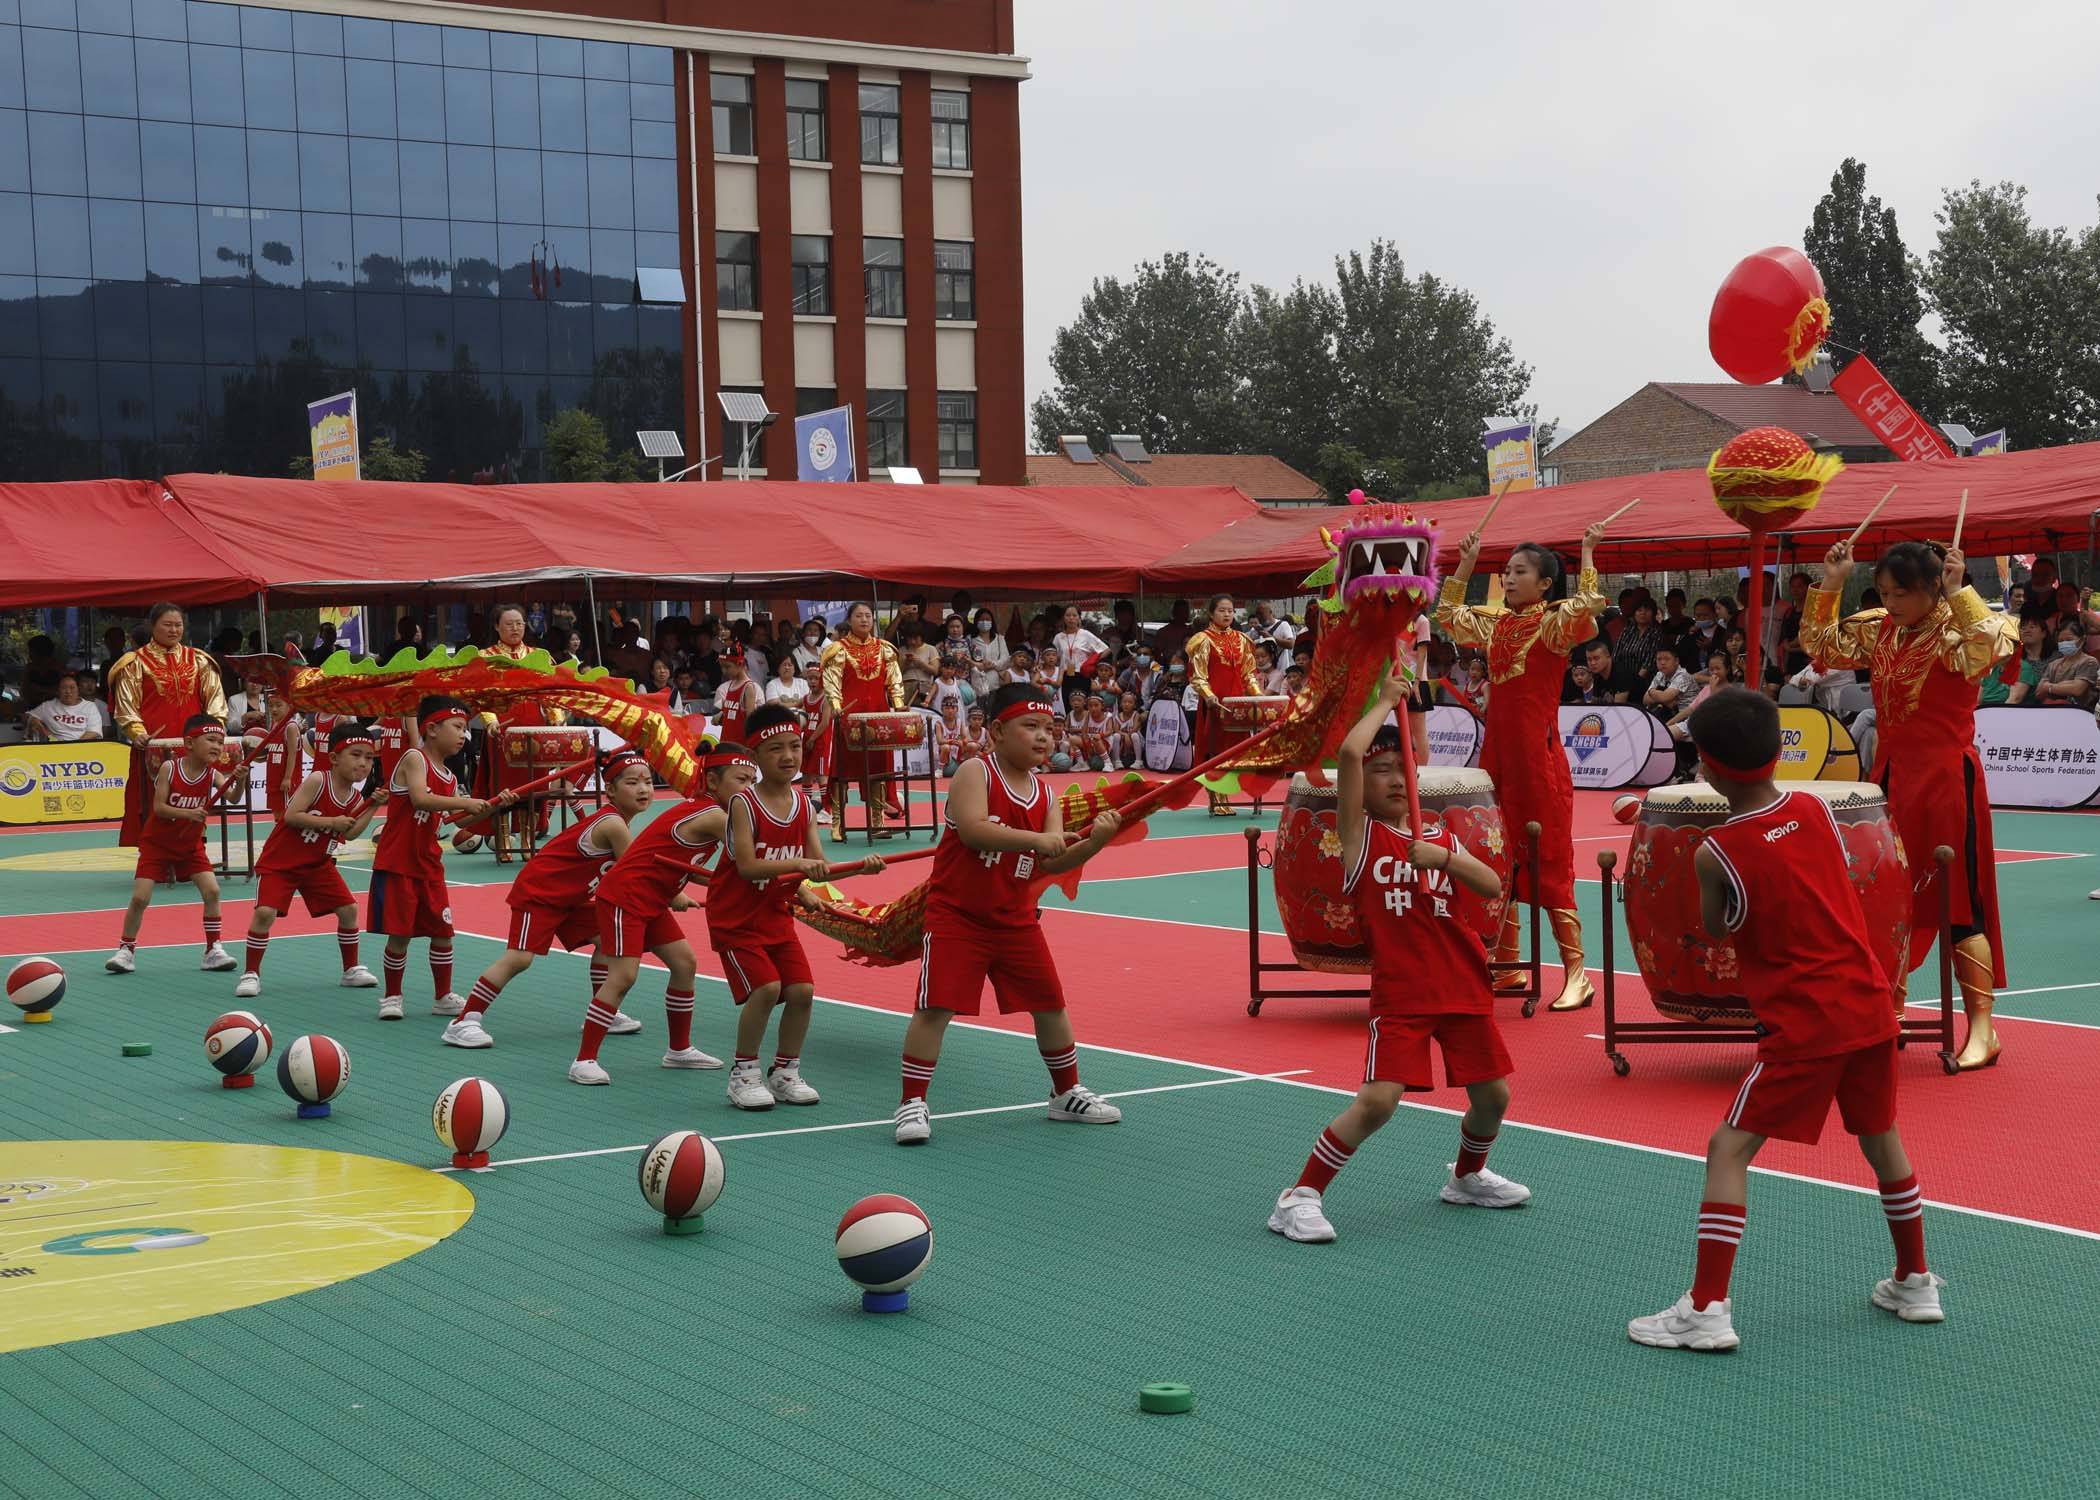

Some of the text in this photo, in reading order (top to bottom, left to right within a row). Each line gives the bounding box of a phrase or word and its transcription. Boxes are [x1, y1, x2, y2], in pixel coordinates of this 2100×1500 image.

[761, 723, 794, 739] CHINA
[1986, 746, 2098, 764] 中国中学生体育协会
[40, 761, 104, 778] NYBO
[1984, 764, 2097, 776] China School Sports Federation
[41, 778, 125, 791] 青少年篮球公开赛
